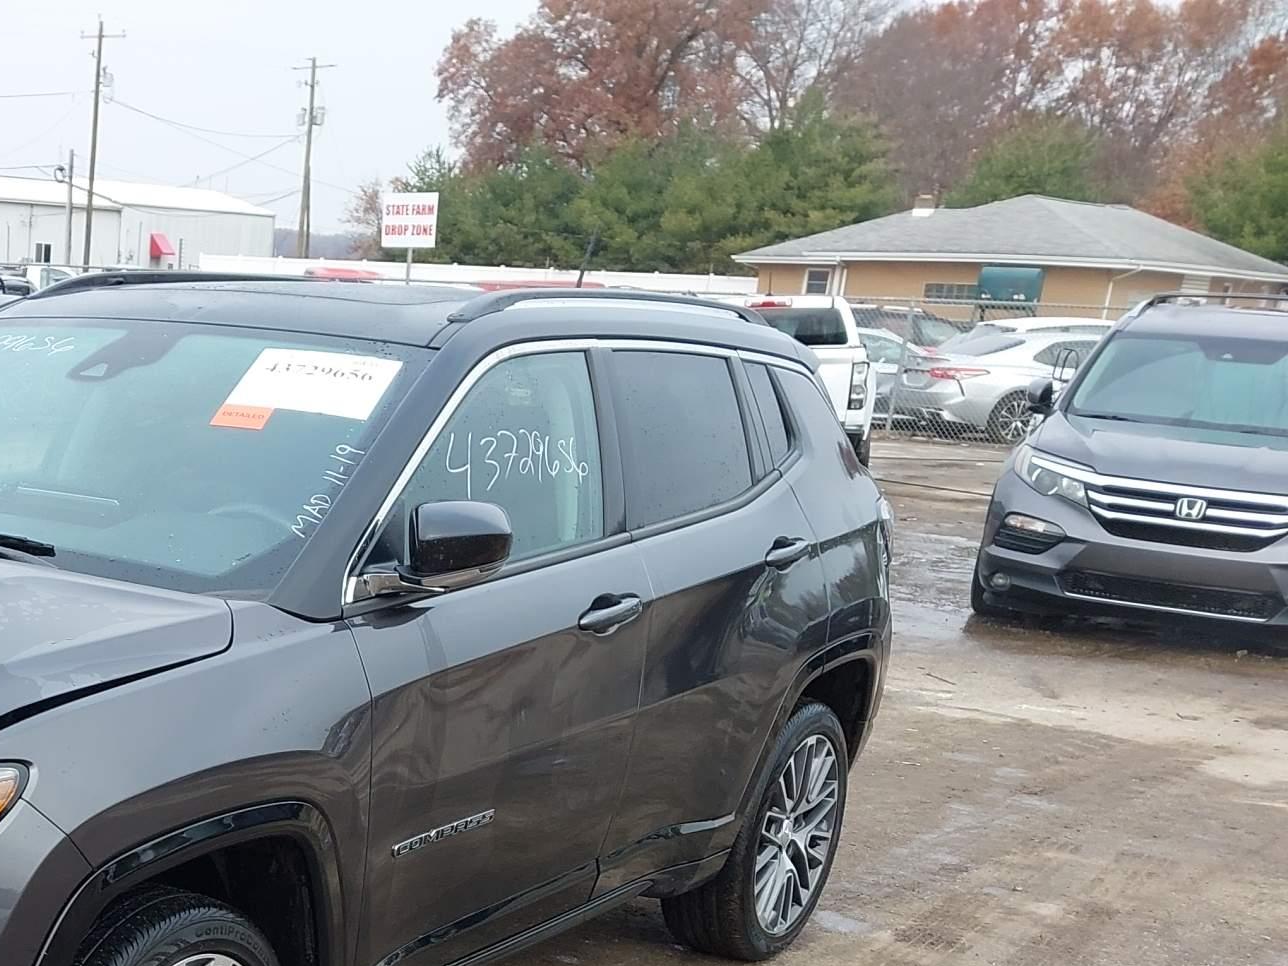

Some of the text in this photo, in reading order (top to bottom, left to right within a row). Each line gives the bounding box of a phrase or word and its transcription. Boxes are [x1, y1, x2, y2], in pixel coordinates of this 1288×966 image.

[384, 224, 433, 236] DROP ZONE
[385, 203, 435, 216] STATE FARM
[446, 429, 589, 500] 43729656
[291, 444, 366, 538] MAD 11-19
[392, 808, 496, 857] COMPASS
